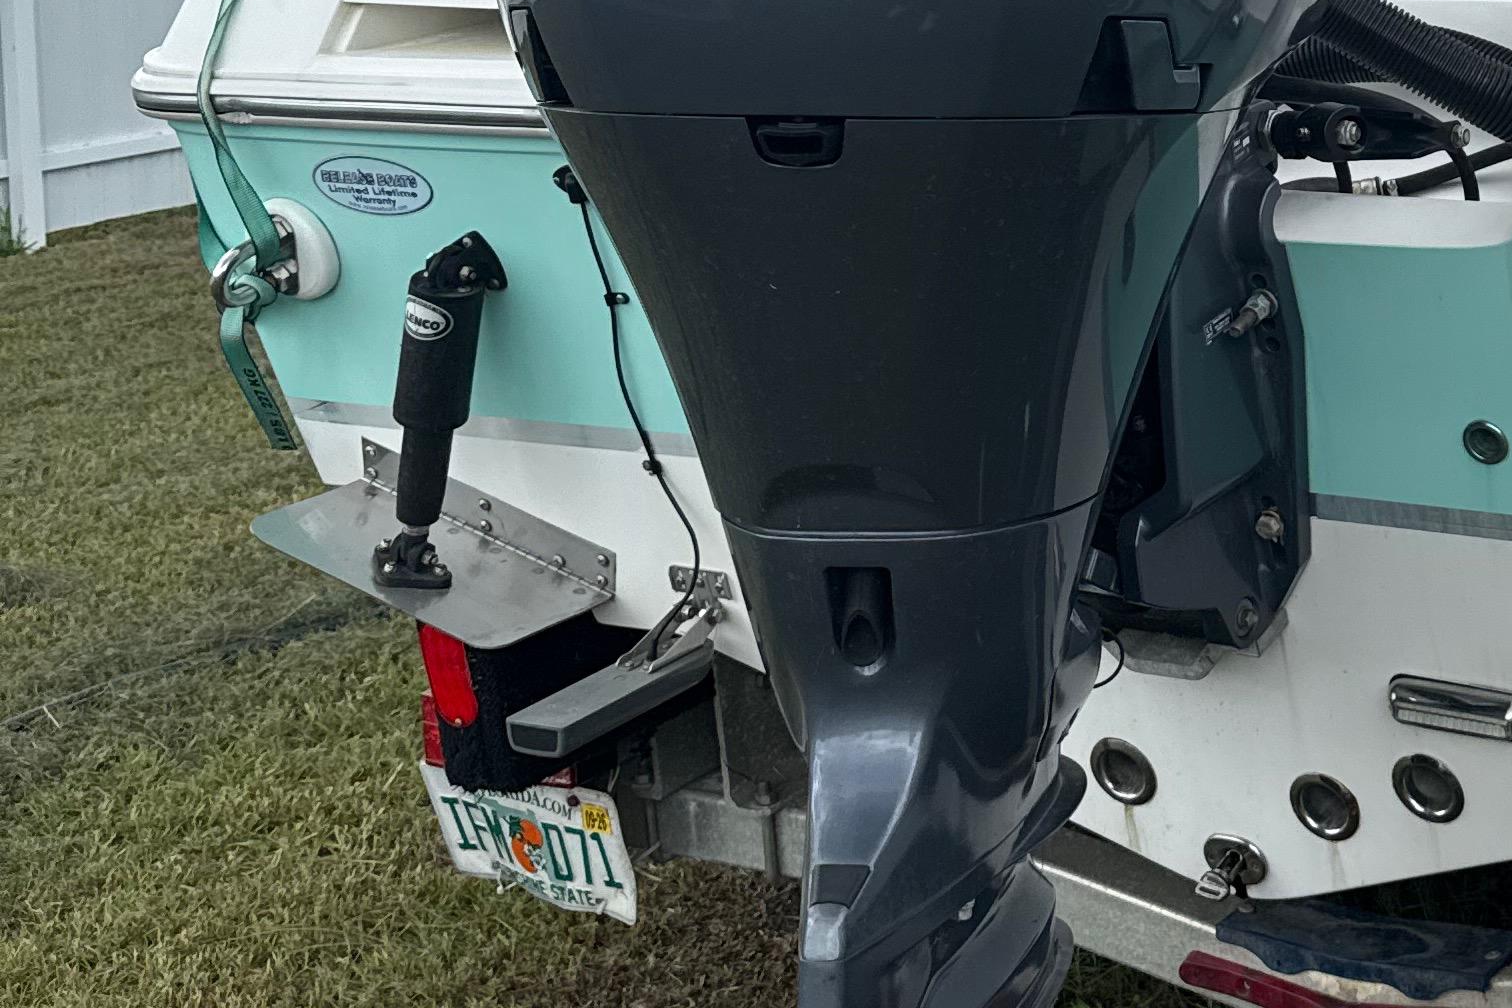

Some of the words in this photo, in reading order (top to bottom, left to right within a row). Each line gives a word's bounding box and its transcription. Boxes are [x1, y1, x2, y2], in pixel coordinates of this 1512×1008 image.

[375, 173, 418, 189] BOATS
[327, 184, 369, 195] Limited
[371, 186, 418, 198] Lifetime
[352, 194, 397, 207] Warranty
[541, 822, 624, 889] D71
[550, 883, 596, 907] STATE
